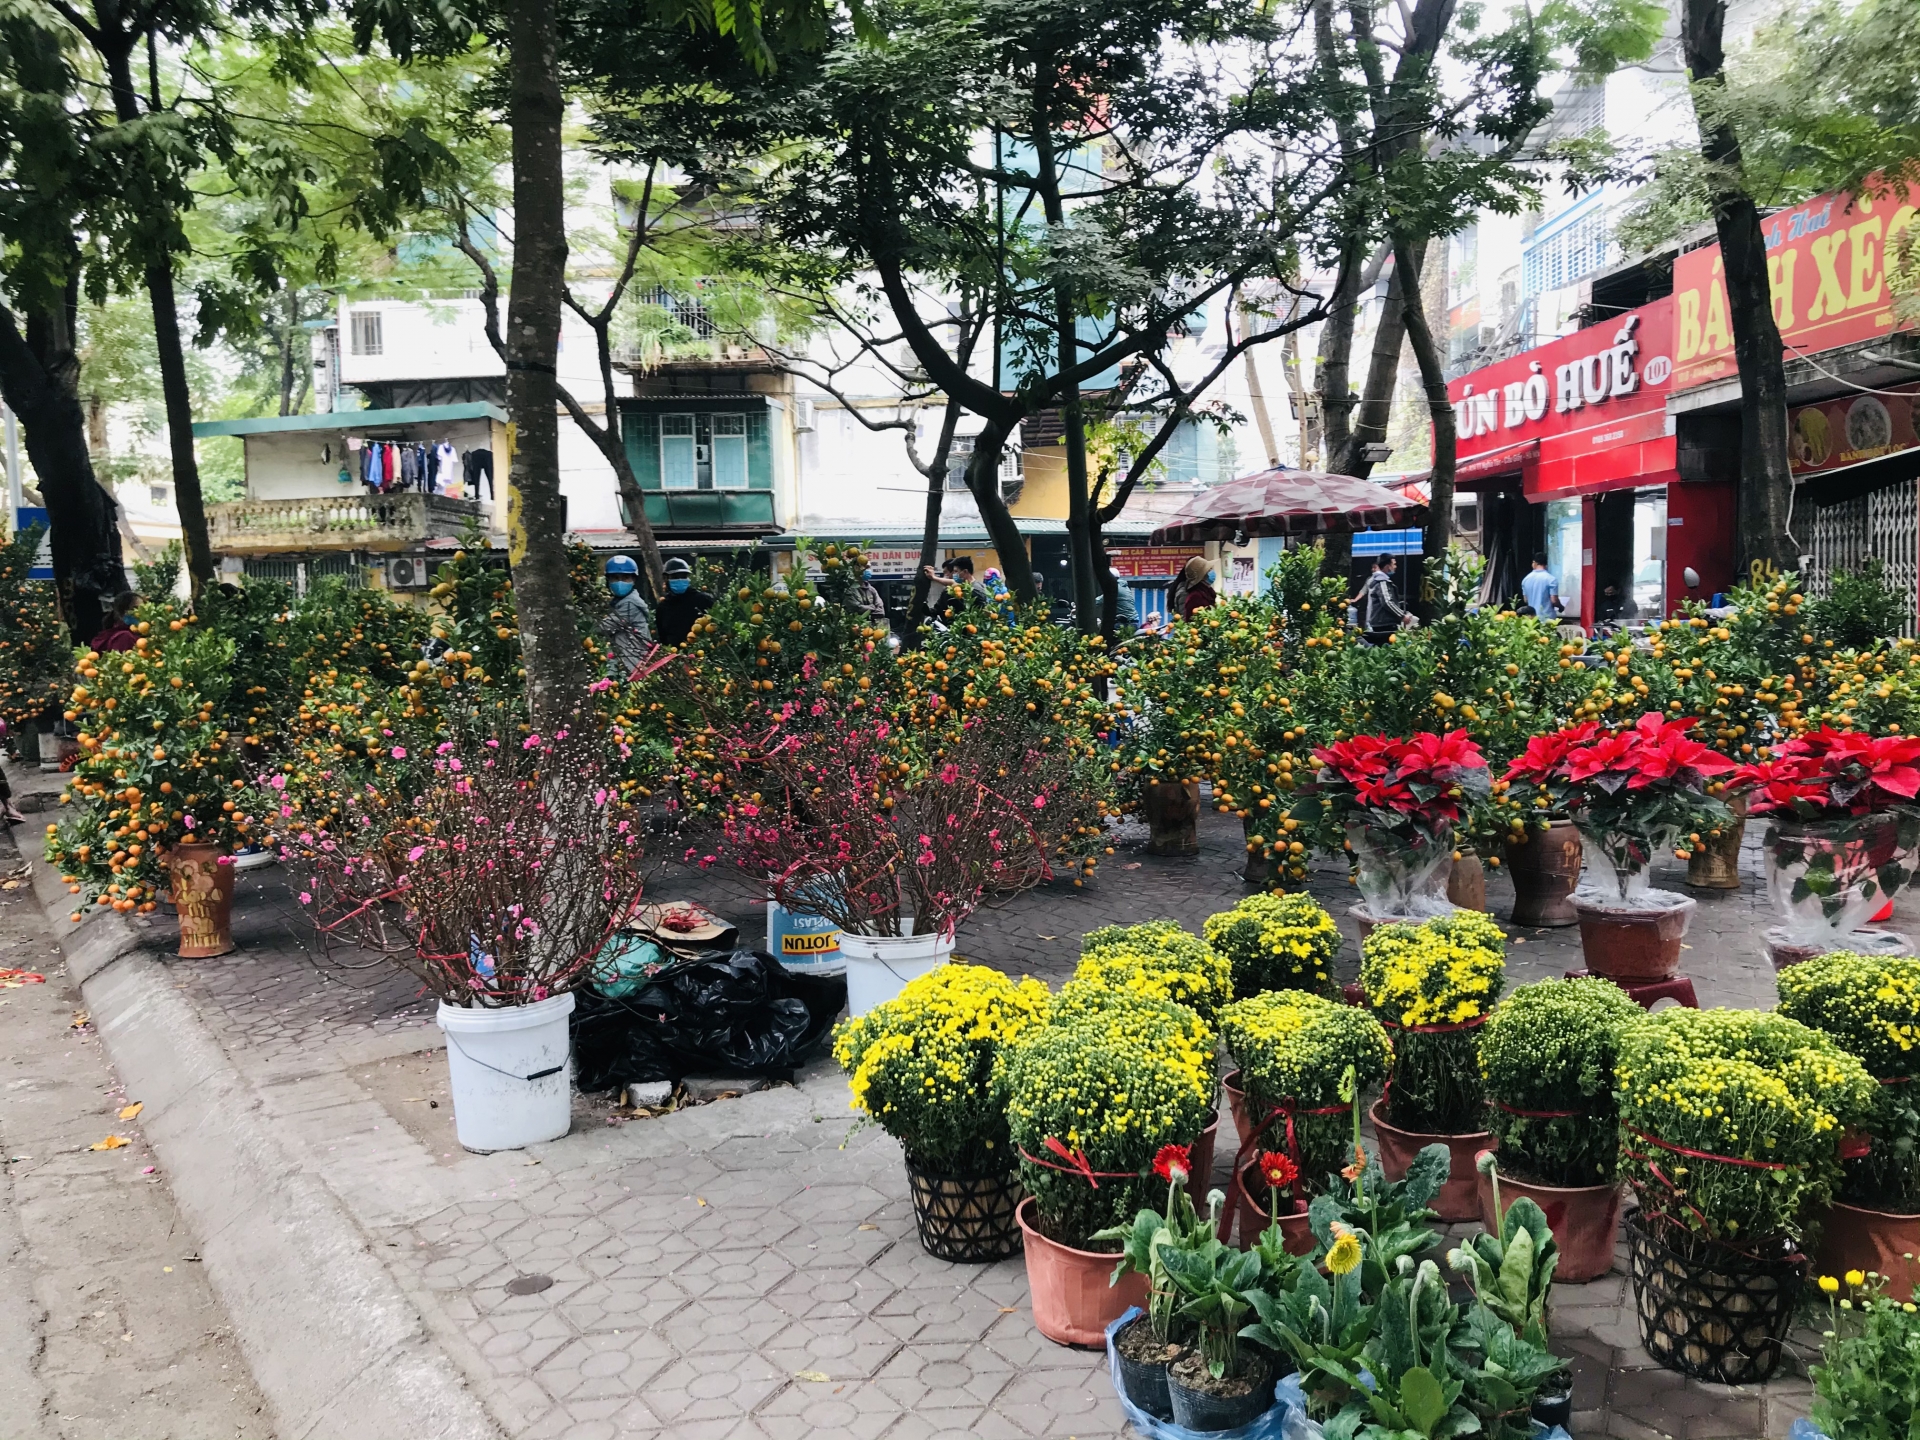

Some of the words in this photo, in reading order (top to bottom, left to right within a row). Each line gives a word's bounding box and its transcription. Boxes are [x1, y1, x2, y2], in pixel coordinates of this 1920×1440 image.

[1677, 249, 1798, 363] BÁH
[1454, 384, 1499, 440] ÚN
[1504, 361, 1549, 428] BÒ
[1555, 315, 1640, 414] HUẾ
[1646, 360, 1669, 381] 101
[785, 935, 831, 950] JOTUN
